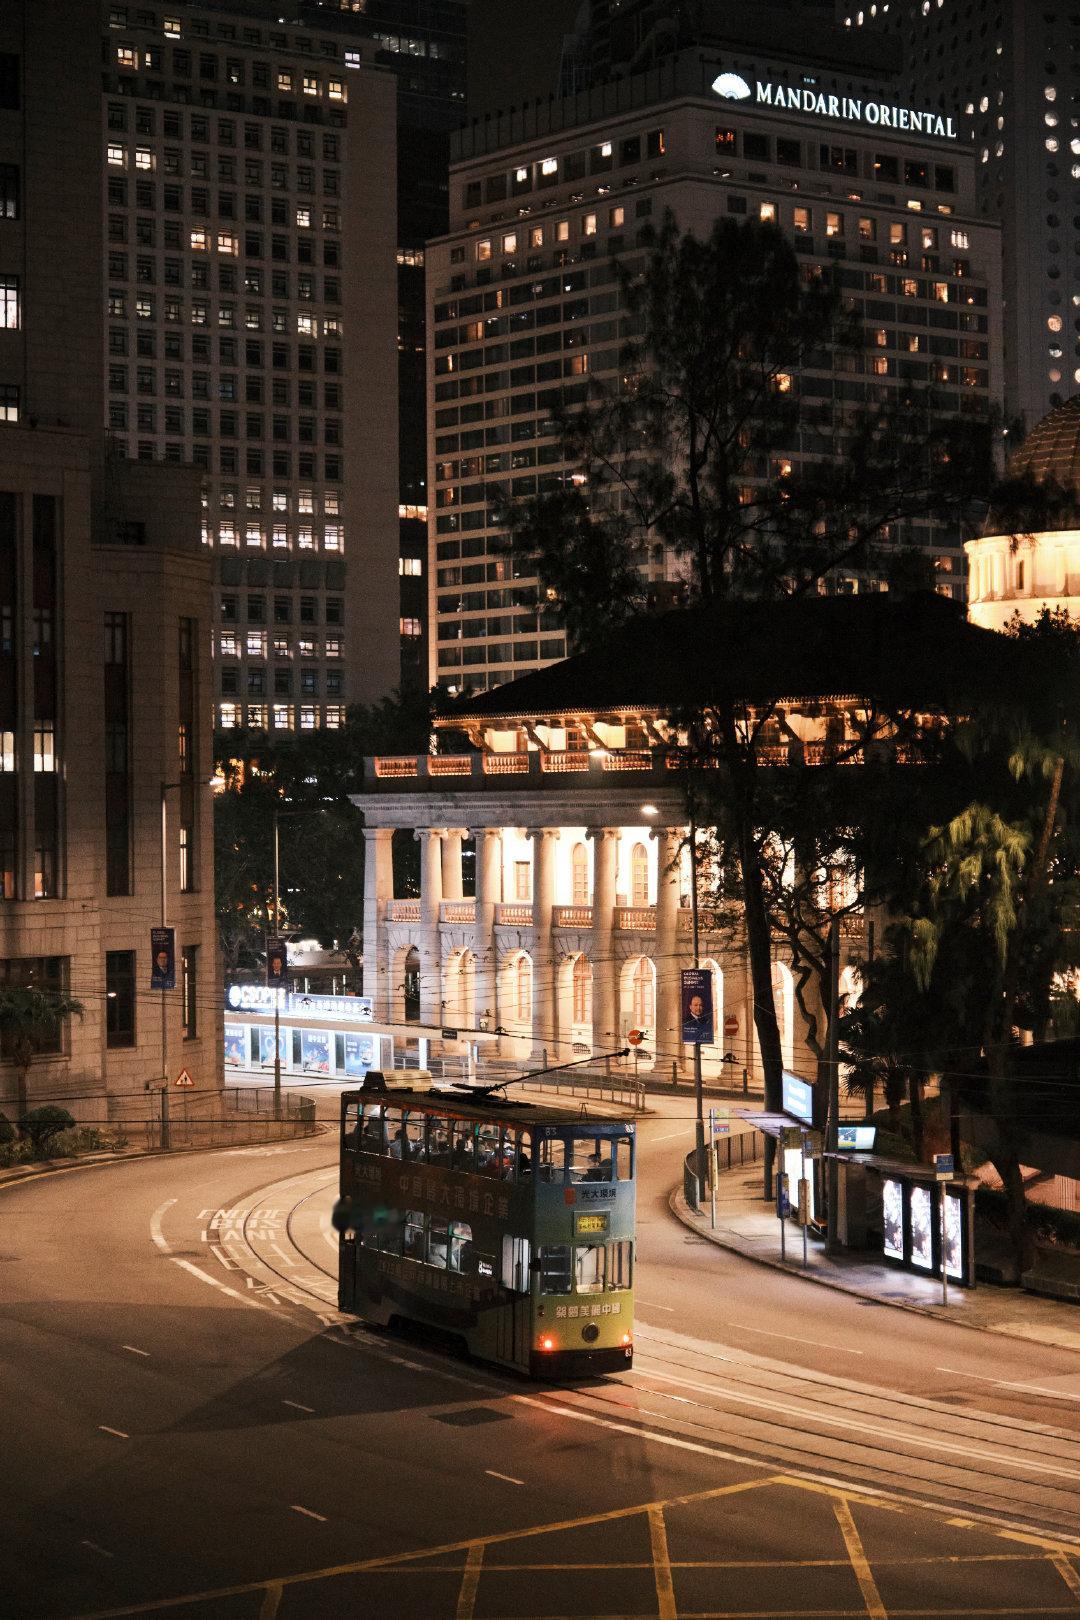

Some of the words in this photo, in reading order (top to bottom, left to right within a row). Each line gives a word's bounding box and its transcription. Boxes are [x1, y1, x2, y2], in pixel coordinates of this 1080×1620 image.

[756, 81, 862, 120] MANDARIN
[865, 103, 957, 138] ORIENTAL
[545, 1127, 557, 1136] 83
[209, 1219, 283, 1229] BUS
